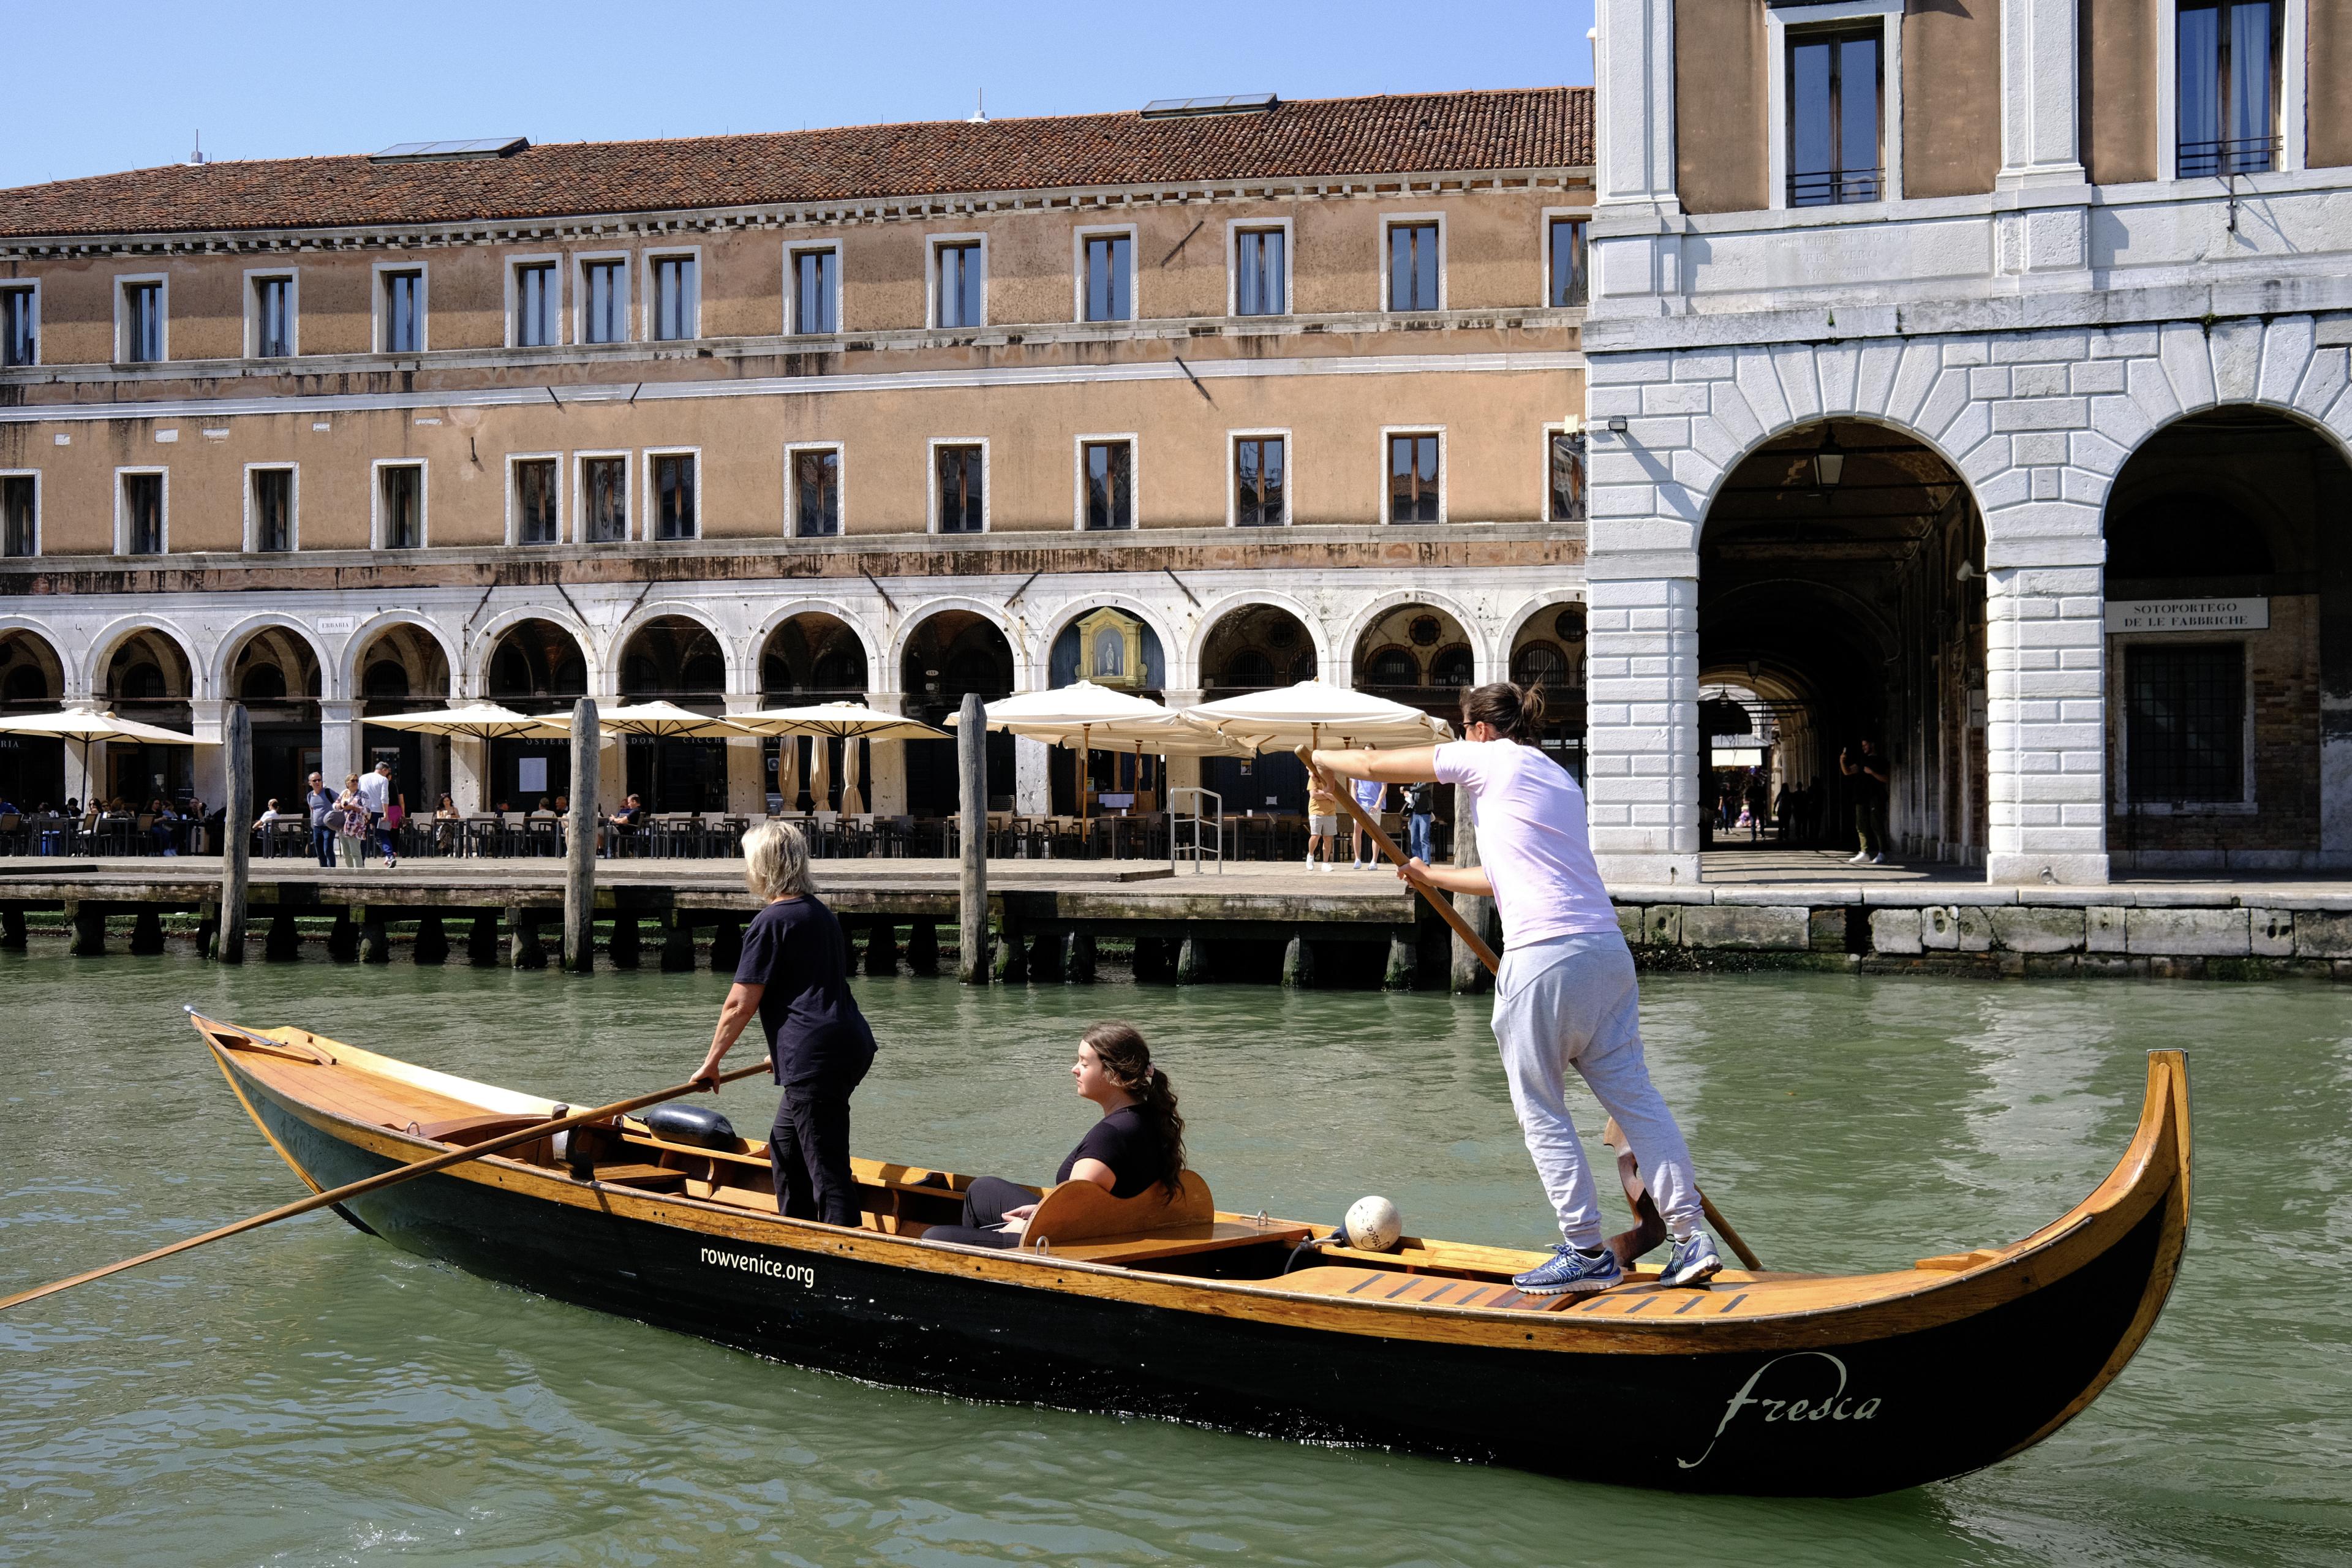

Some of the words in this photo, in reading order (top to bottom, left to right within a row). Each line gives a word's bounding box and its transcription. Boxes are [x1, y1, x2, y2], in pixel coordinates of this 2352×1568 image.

[1768, 238, 1801, 250] ANNO
[1806, 234, 1854, 247] CHRISTI
[1841, 249, 1878, 261] VERO
[2133, 602, 2237, 614] SOTOPORTEGO
[2124, 617, 2143, 627] DE
[2148, 617, 2166, 627] LE
[2172, 615, 2248, 626] FABBRICHE
[0, 739, 20, 748] RIA
[701, 1247, 814, 1289] rowvenice.org
